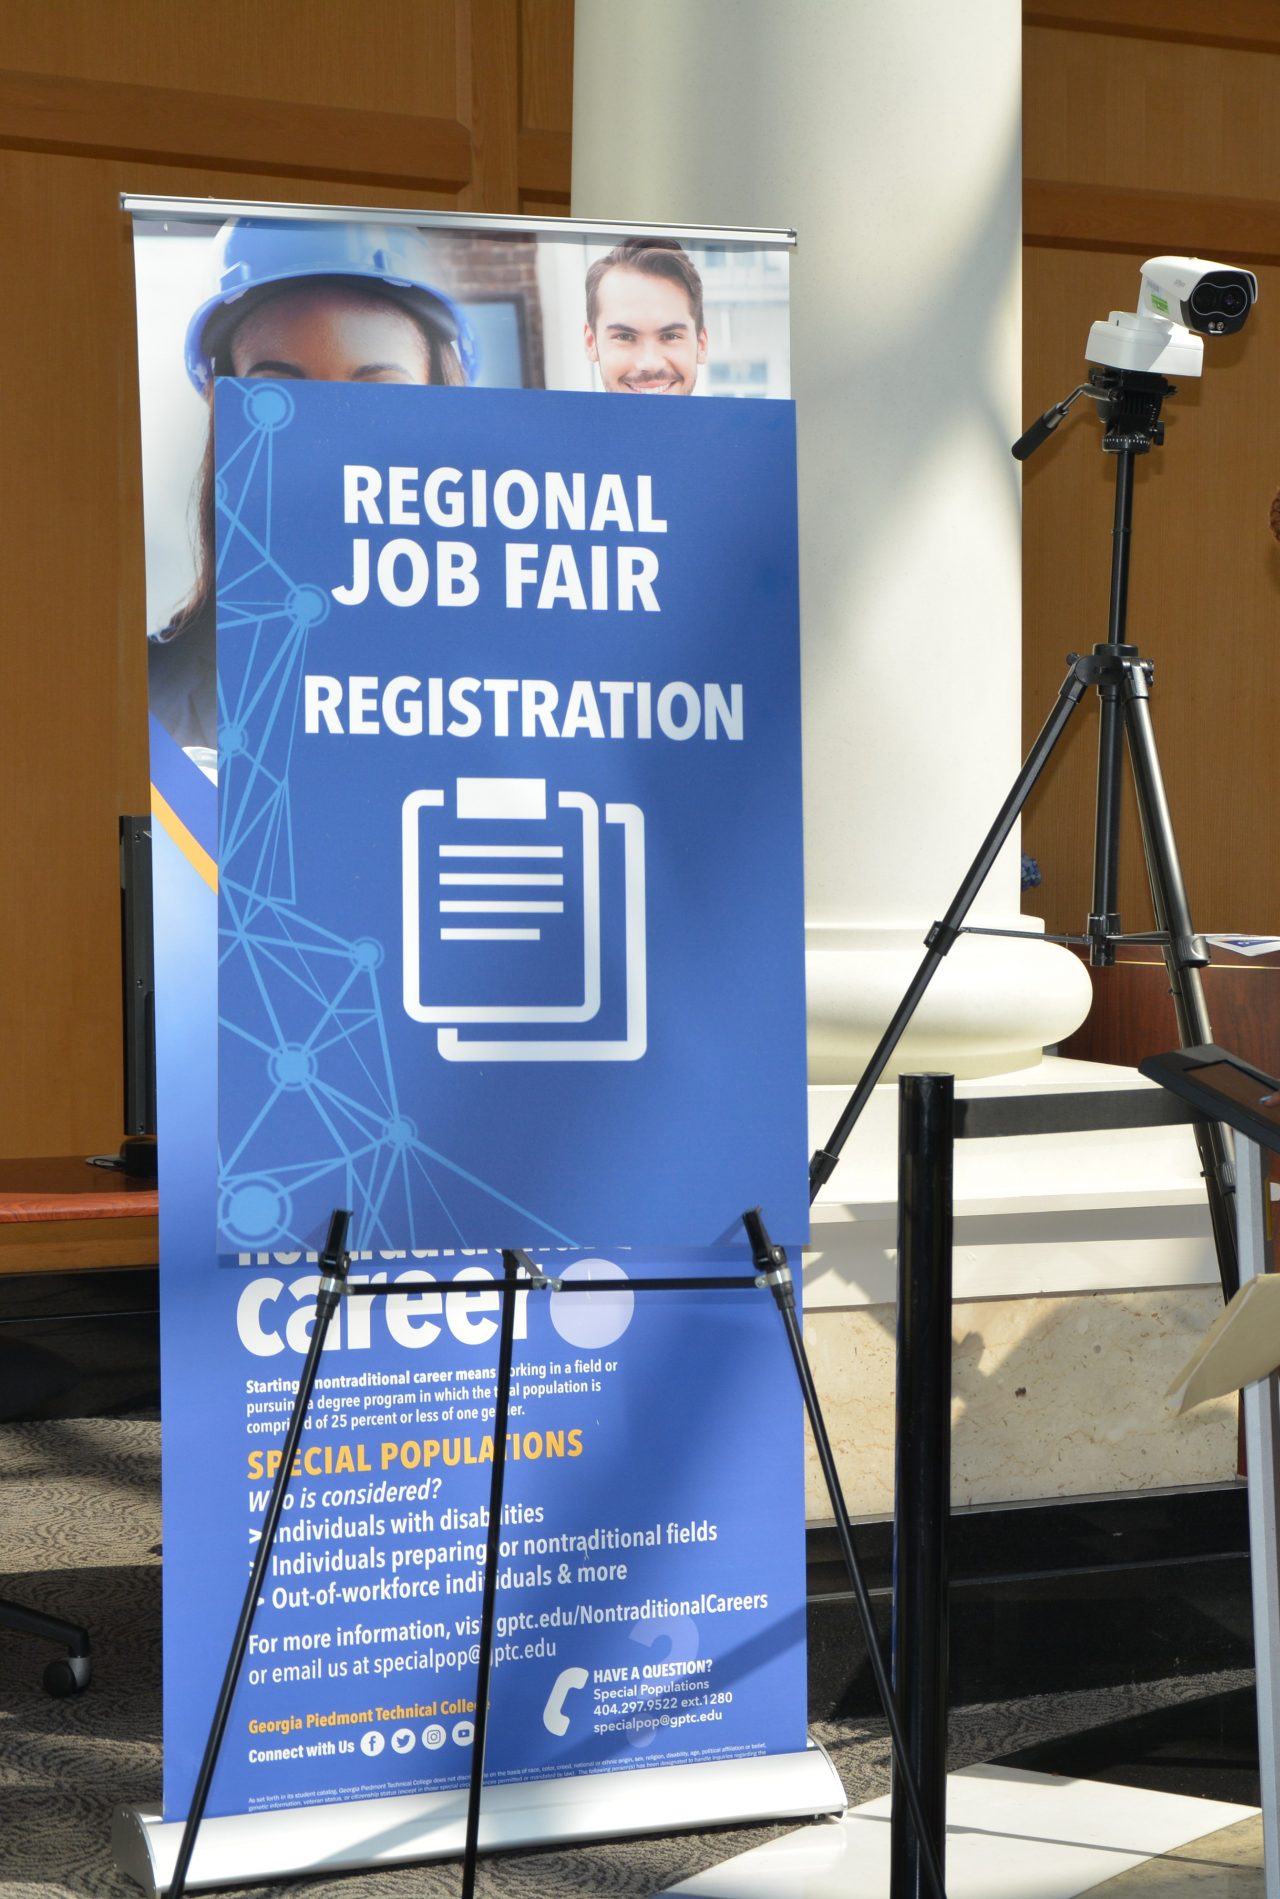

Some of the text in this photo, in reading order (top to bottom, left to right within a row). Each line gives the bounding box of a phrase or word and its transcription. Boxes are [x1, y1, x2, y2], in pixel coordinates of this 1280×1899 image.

[343, 464, 668, 533] REGIONAL
[331, 538, 662, 612] JOB FAIR
[304, 674, 745, 741] REGISTRATION
[236, 1264, 543, 1357] career
[246, 1359, 618, 1394] Starting nontraditional career means orking in a field or
[246, 1378, 602, 1417] pursuin a degree program in which the tal population is
[246, 1403, 525, 1436] comprid of 25 percent or less of one geer.
[247, 1443, 372, 1480] SPECIAL
[249, 1477, 443, 1513] Wo is considered?
[391, 1510, 434, 1535] with
[272, 1519, 718, 1577] Individuals preparing or nontraditional fields
[272, 1563, 628, 1610] Out-of-workforce indiiduals & more
[249, 1593, 768, 1655] For more information, vis gptc.edu/NontraditionalCareers
[248, 1637, 557, 1685] or email us at specialpop@ptc.edu
[593, 1658, 713, 1684] HAVE A QUESTION?
[593, 1679, 710, 1702] Special Populations
[593, 1691, 733, 1716] 404.297.9522 ext.1280
[248, 1698, 490, 1734] Georgia Piedmont Technical Colle
[593, 1708, 723, 1734] specialpop@gptc.edu
[248, 1739, 355, 1763] Connect with Us
